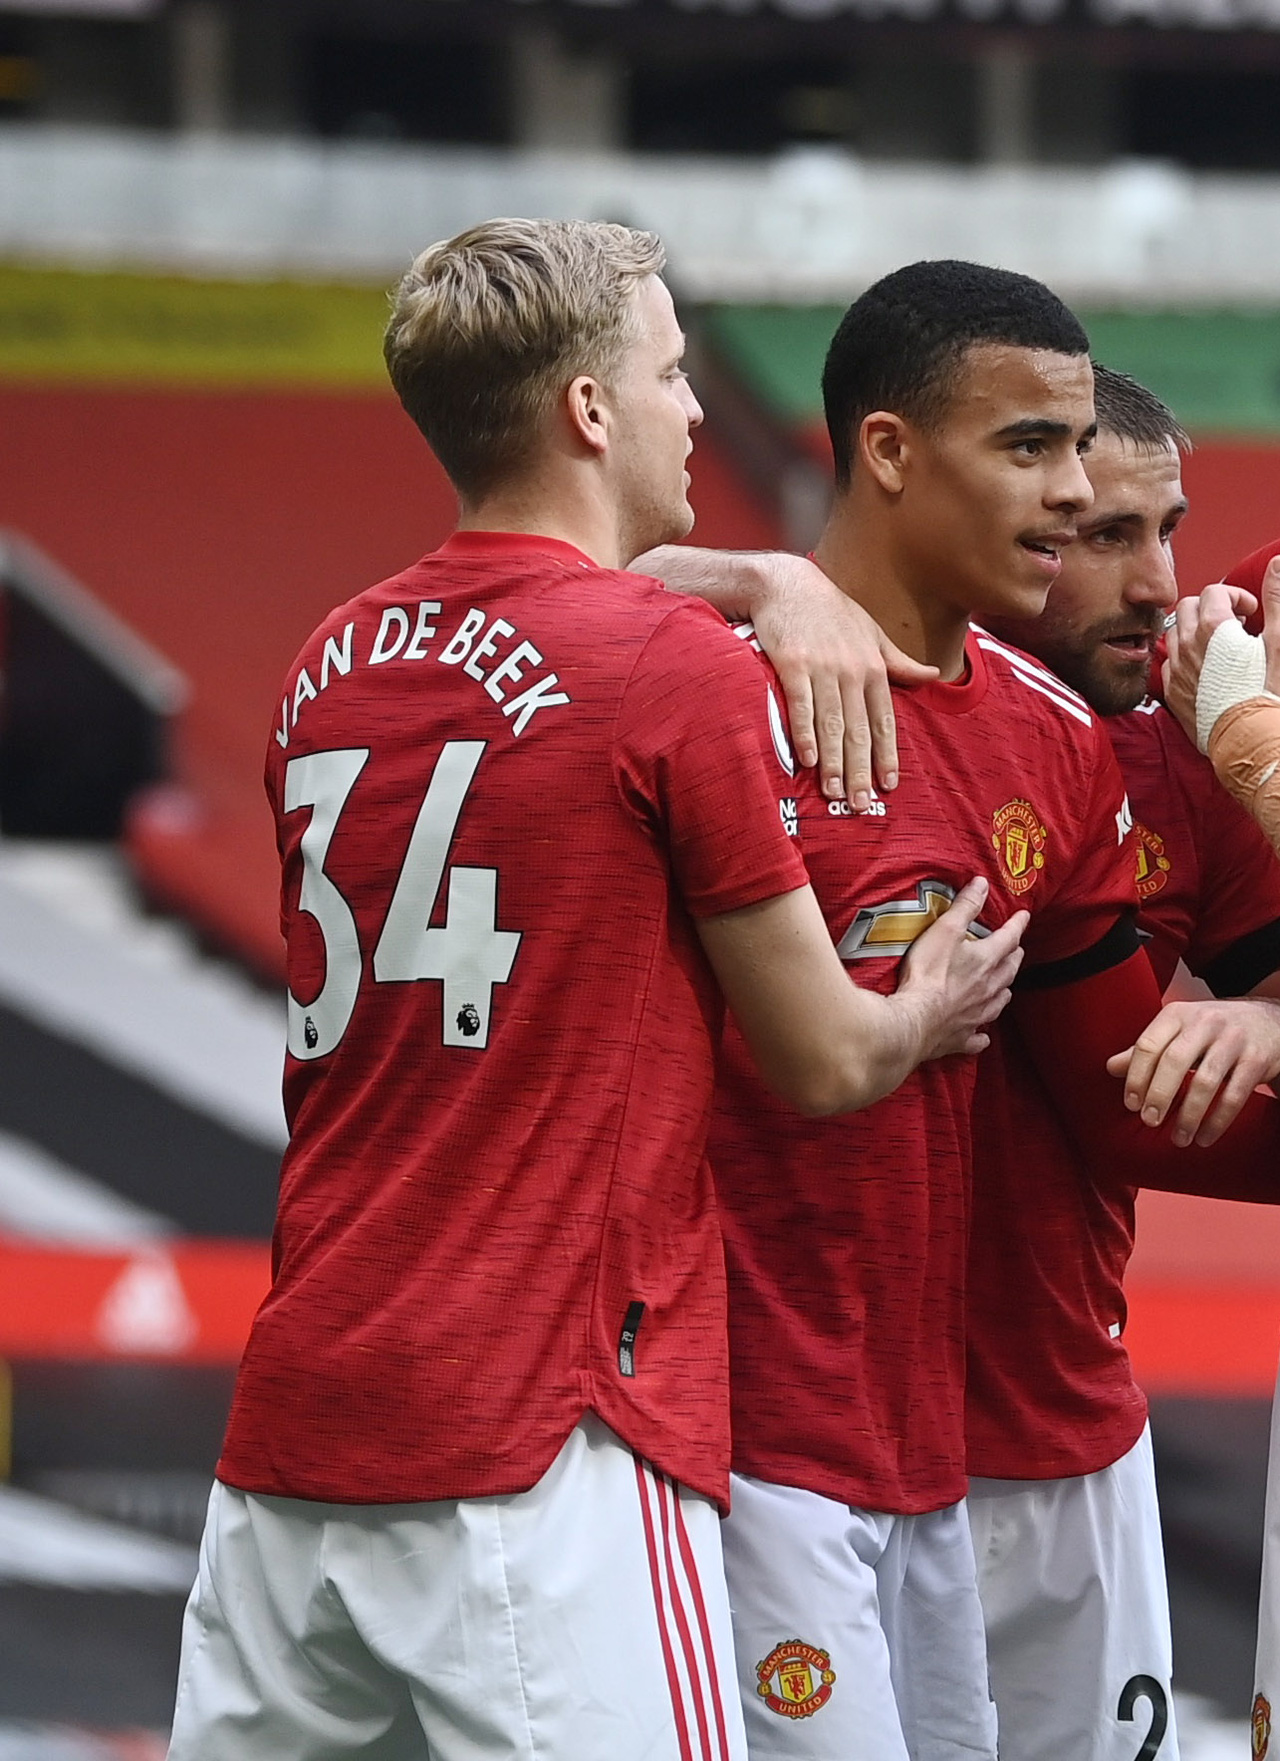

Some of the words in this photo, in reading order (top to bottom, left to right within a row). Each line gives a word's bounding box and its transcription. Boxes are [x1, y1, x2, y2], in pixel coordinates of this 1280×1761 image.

[275, 621, 355, 750] VAN
[367, 600, 443, 666] DE
[437, 606, 571, 737] BEEK
[996, 805, 1040, 844] MANCHESTER
[284, 739, 524, 1061] 34
[762, 1645, 824, 1677] MANCHESTER
[779, 1696, 822, 1714] UNITED
[1117, 1673, 1168, 1761] 2
